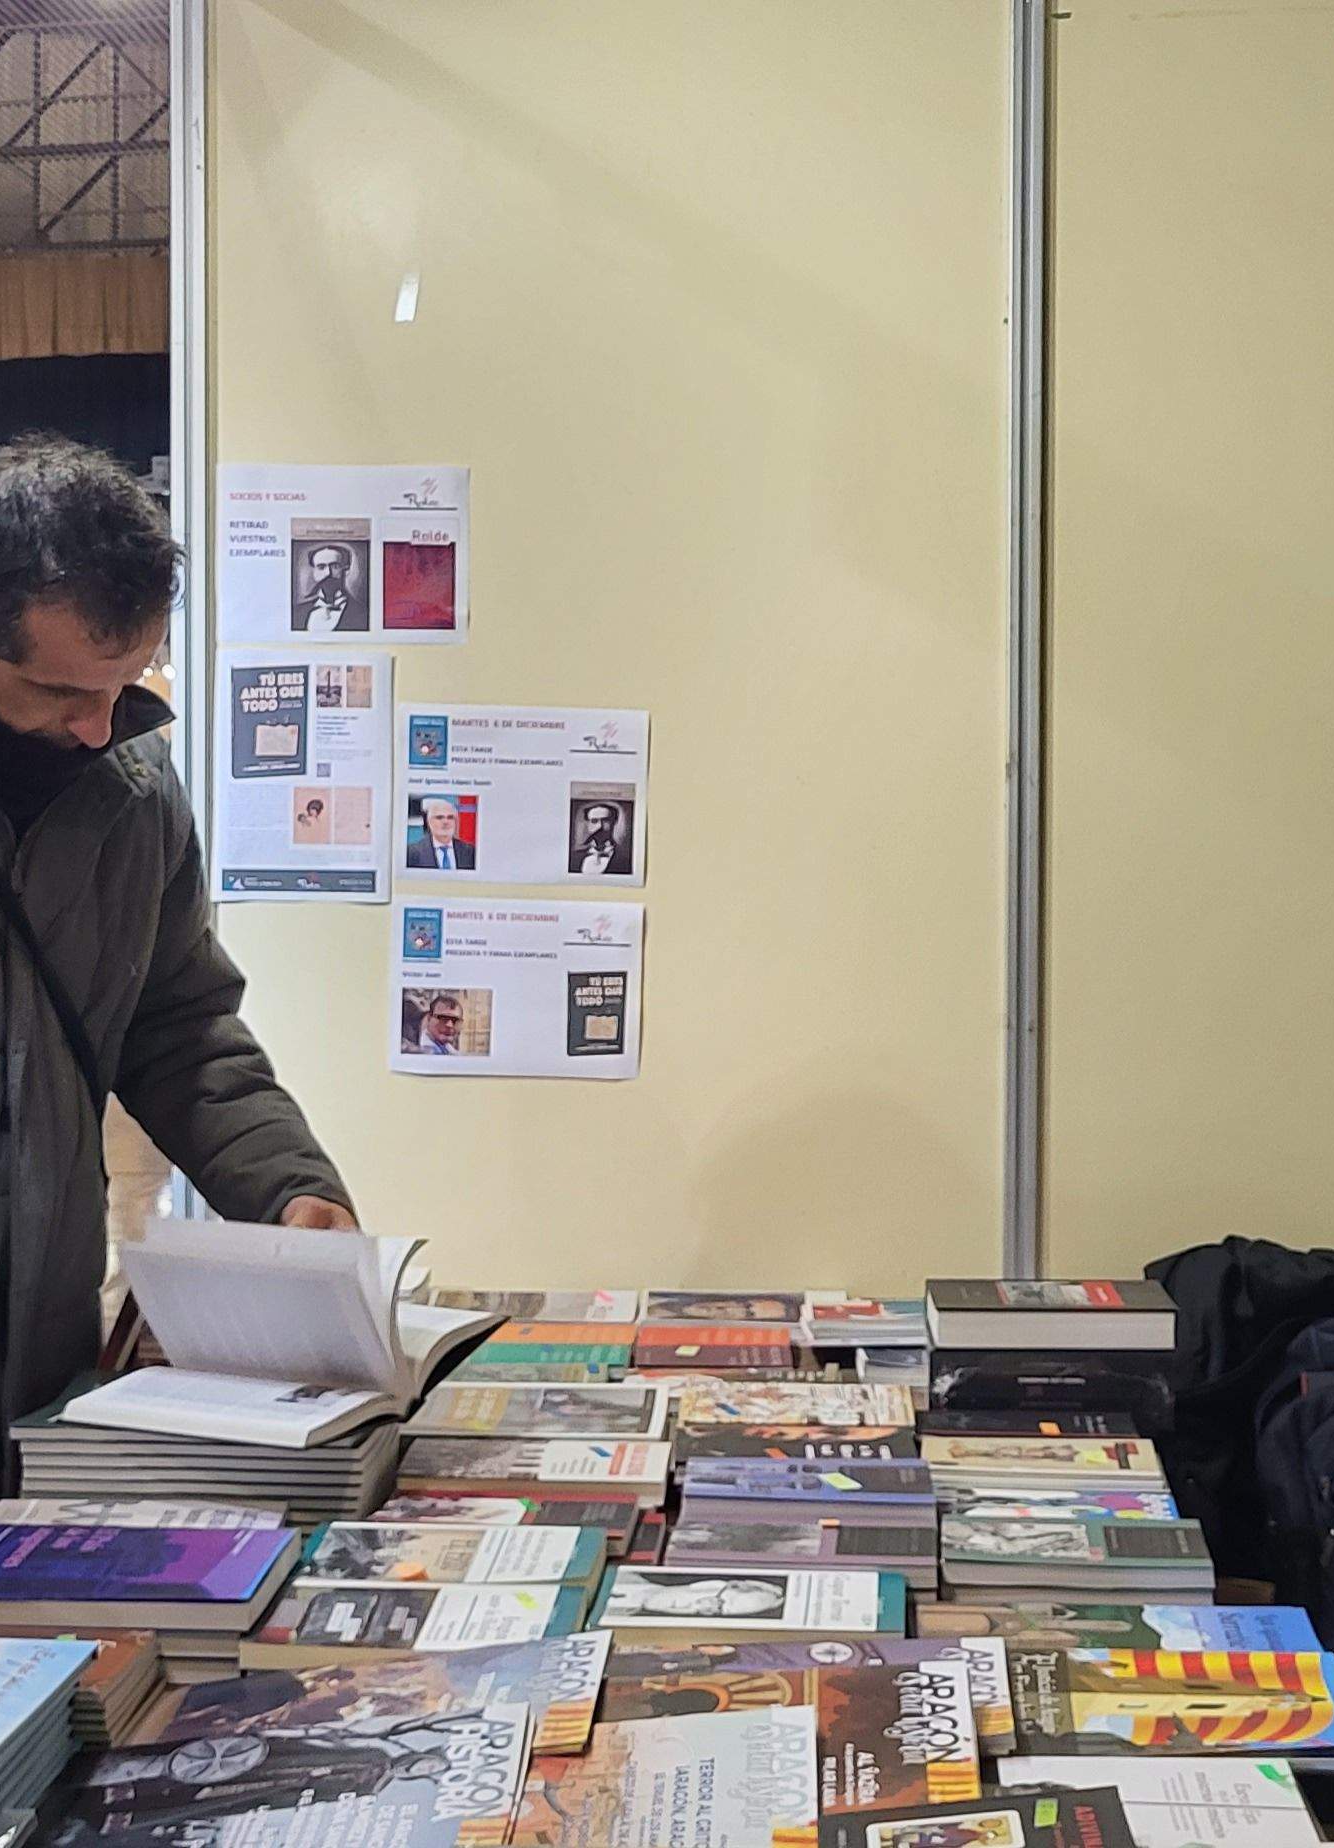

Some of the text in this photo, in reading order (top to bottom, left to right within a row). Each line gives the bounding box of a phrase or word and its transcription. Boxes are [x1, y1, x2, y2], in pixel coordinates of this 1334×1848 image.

[412, 529, 450, 542] Rolde
[242, 699, 279, 713] TODO
[551, 1638, 598, 1703] ARAGÓN
[921, 1671, 971, 1764] ARAGÓN
[431, 1722, 488, 1823] HISTORIA
[467, 1719, 517, 1820] ARAGÓN
[698, 1757, 715, 1802] TERROR
[696, 1804, 712, 1817] AL
